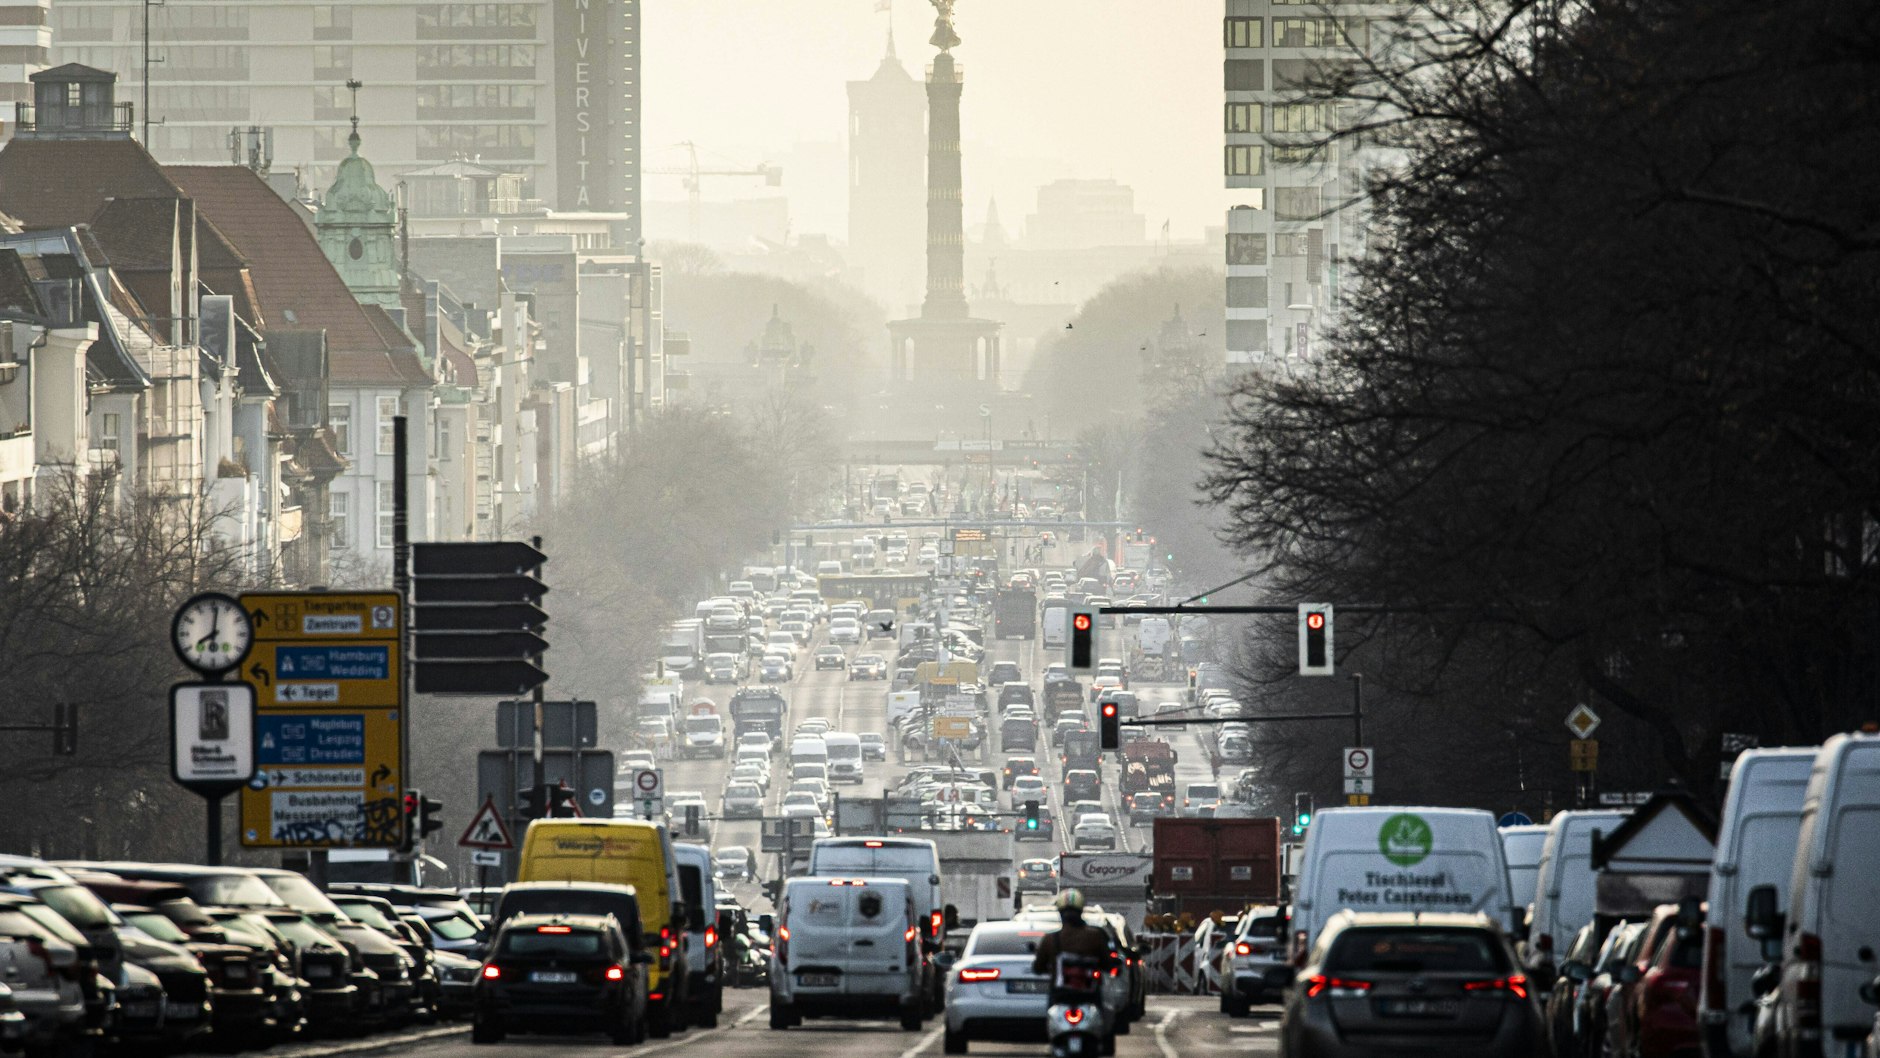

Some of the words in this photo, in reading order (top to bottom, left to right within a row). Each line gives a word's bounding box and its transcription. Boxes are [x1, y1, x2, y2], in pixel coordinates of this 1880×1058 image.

[304, 600, 366, 614] Tiergarten
[306, 618, 358, 630] Zentrum
[328, 650, 385, 663] Hamburg
[328, 665, 383, 678] Wedding
[302, 686, 335, 700] Tegel
[318, 733, 362, 747] Leipzig
[310, 747, 362, 759] Dresden
[1338, 888, 1378, 904] Peter
